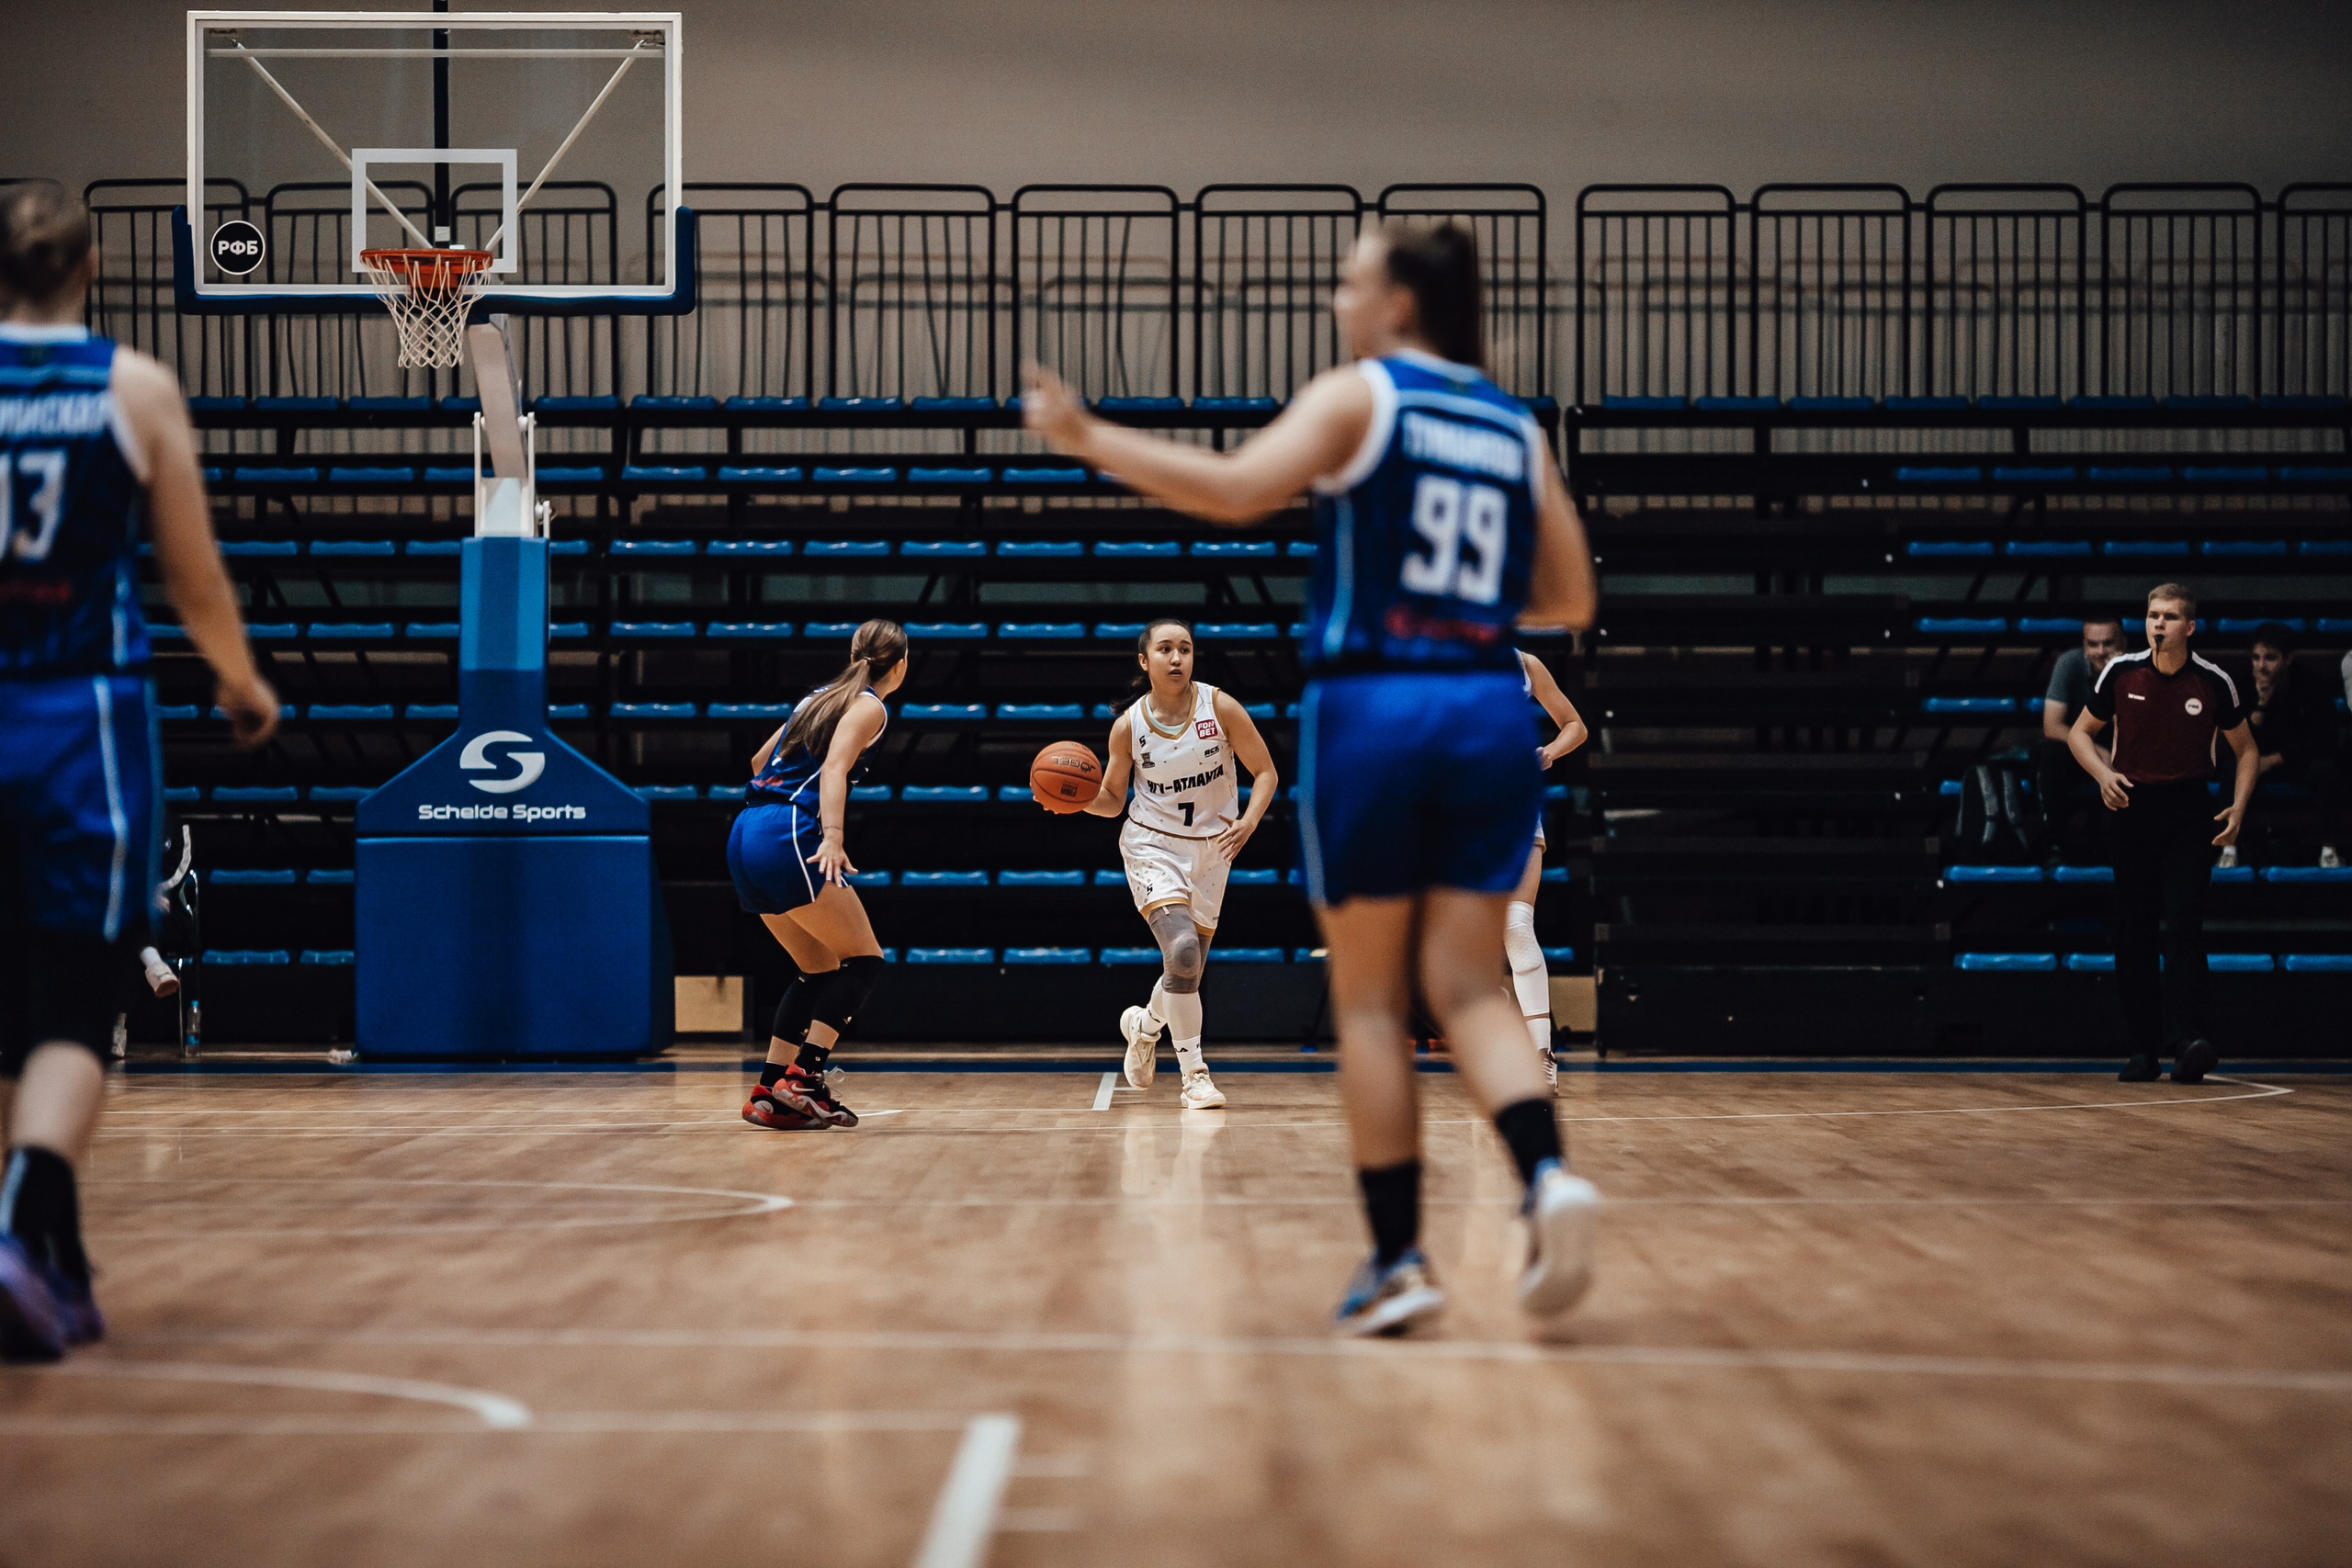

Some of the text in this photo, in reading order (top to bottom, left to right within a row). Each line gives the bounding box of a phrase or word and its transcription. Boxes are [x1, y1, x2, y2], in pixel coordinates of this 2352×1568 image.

[218, 240, 259, 255] РФБ
[1400, 474, 1509, 605] 99
[1197, 721, 1215, 730] FON
[1199, 727, 1216, 738] BET
[419, 805, 586, 823] Schelde Sports
[1178, 802, 1194, 827] 7
